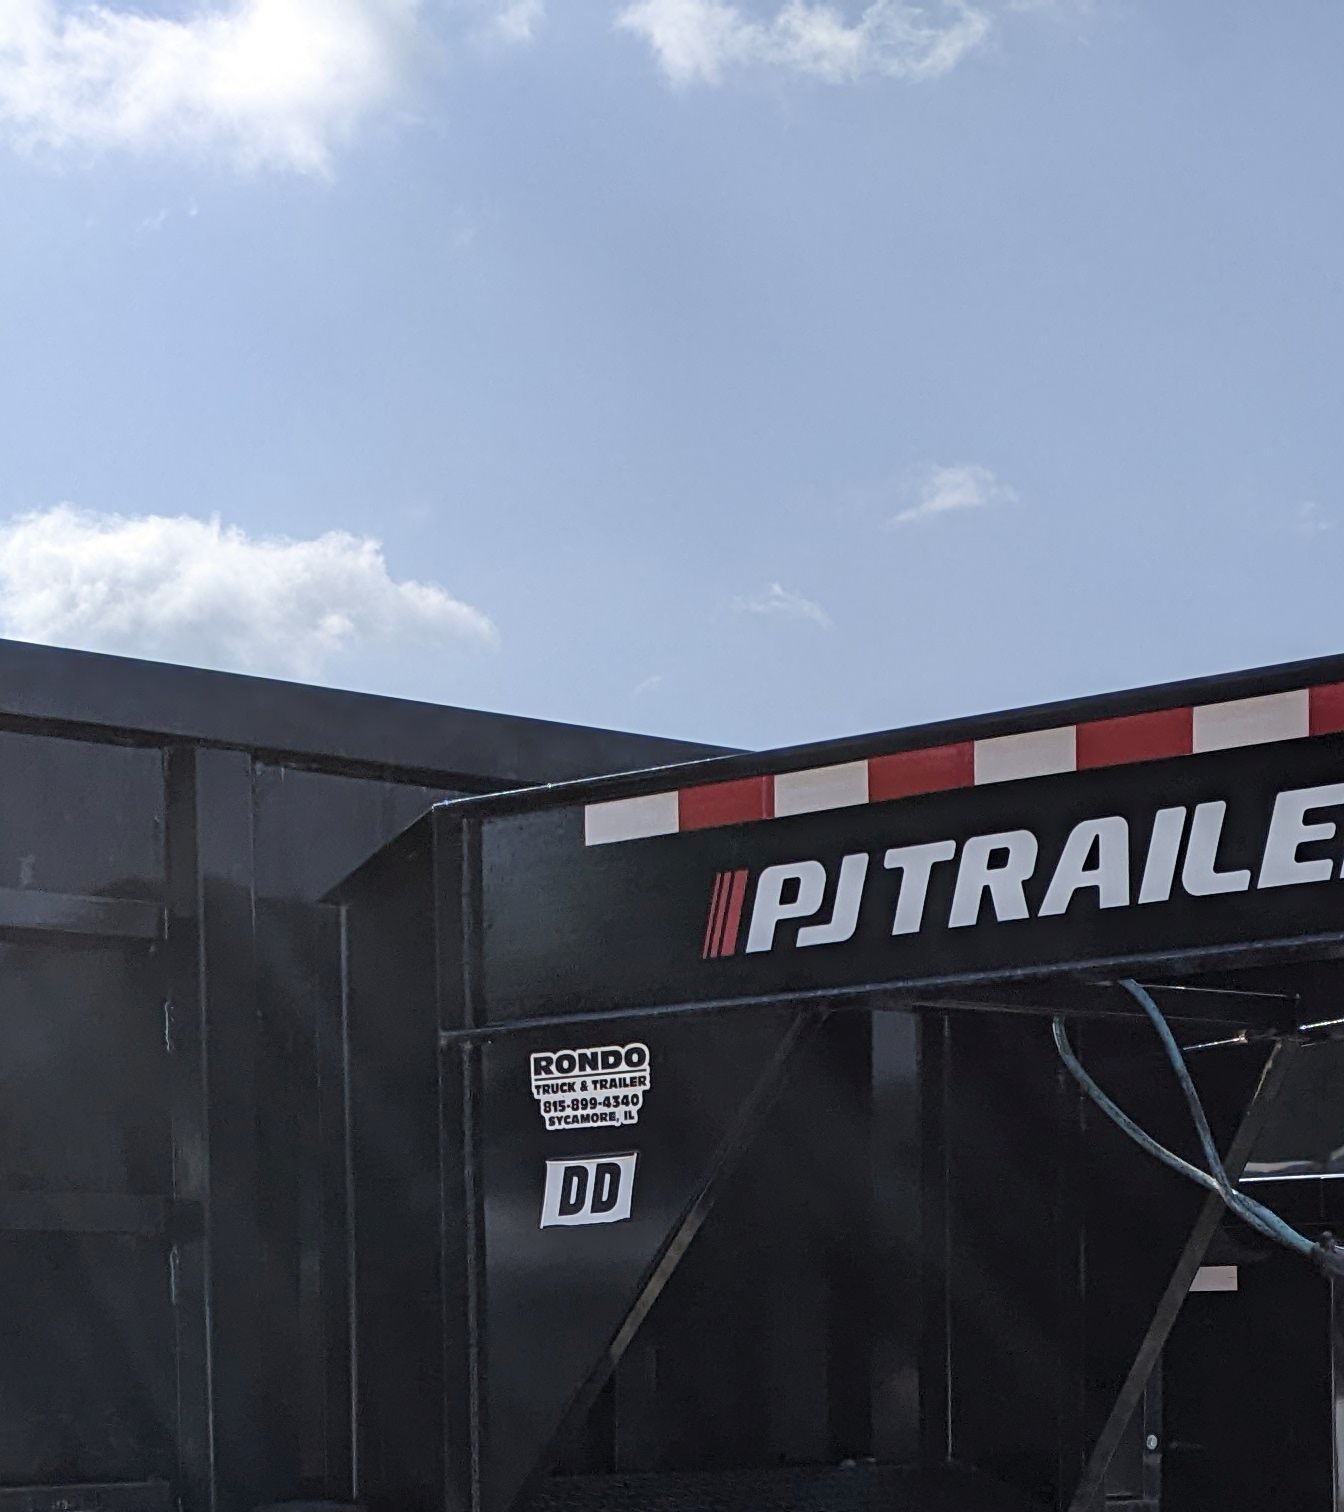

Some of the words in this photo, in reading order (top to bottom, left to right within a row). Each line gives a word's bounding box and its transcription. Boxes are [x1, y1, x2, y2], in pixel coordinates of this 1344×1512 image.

[533, 1047, 647, 1076] RONDO
[535, 1081, 576, 1096] TRUCK
[580, 1080, 589, 1092] &
[592, 1075, 647, 1091] TRAILER
[543, 1093, 640, 1114] 815-899-4340
[548, 1111, 620, 1127] SYCAMORE,
[624, 1110, 635, 1121] IL
[558, 1162, 622, 1217] DD
